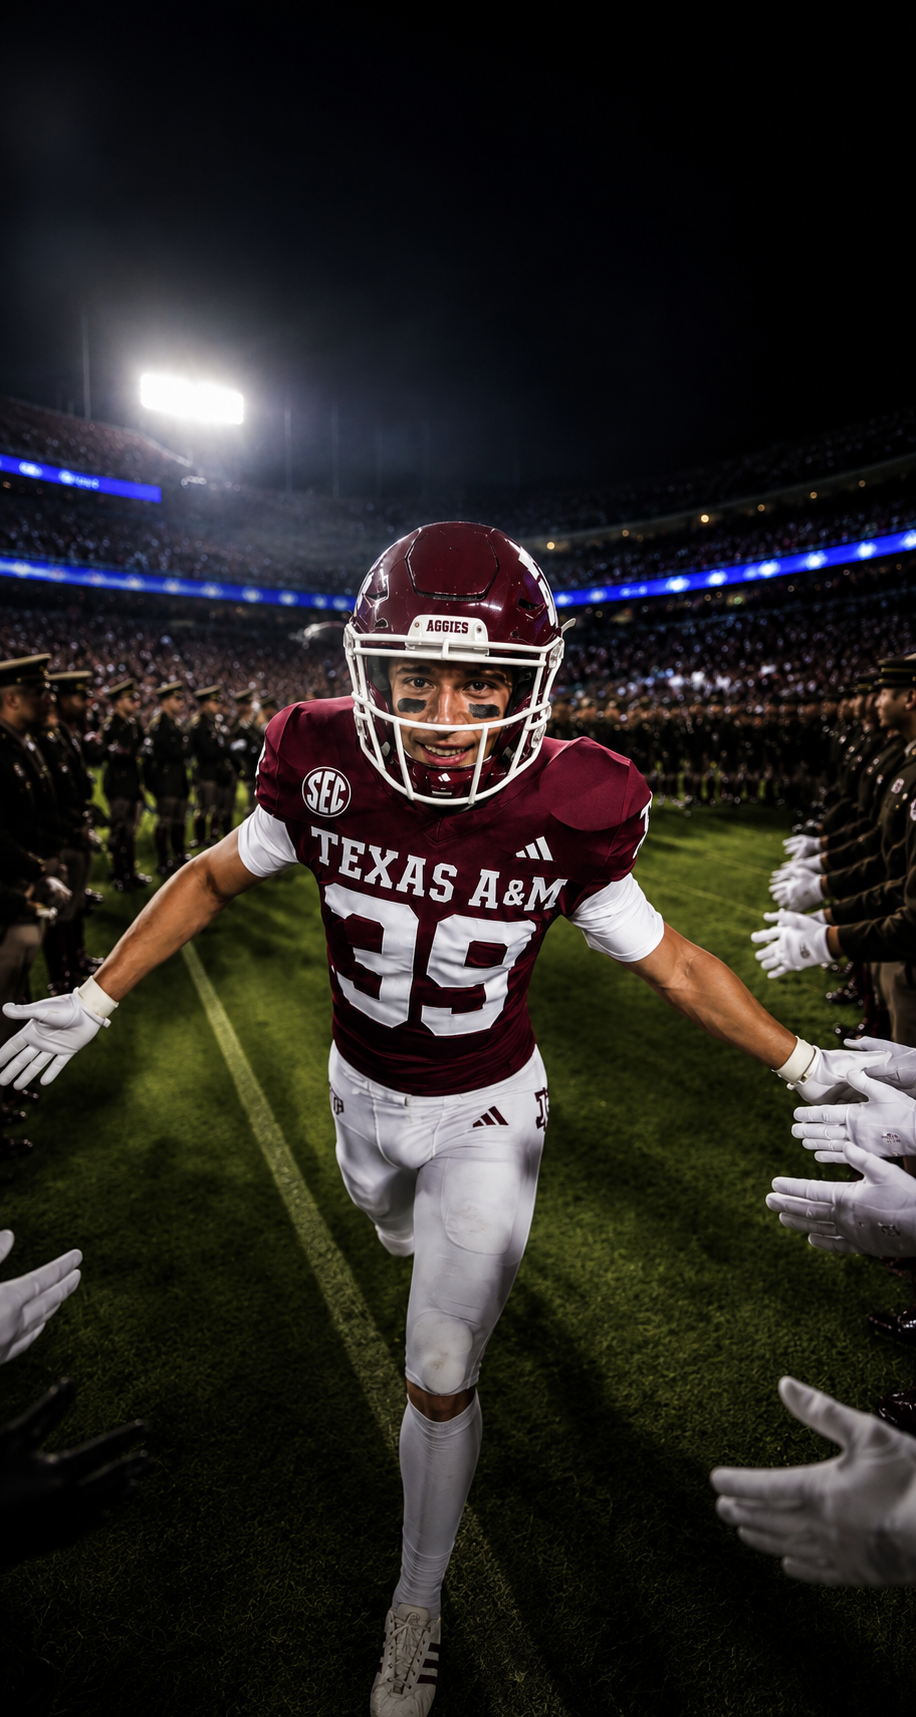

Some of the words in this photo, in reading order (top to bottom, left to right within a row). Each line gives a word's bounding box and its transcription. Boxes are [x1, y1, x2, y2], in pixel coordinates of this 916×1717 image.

[426, 619, 469, 634] AGGIES
[306, 770, 346, 814] SEC
[310, 826, 458, 903] TEXAS
[467, 868, 569, 911] A&M
[324, 882, 537, 1036] 39
